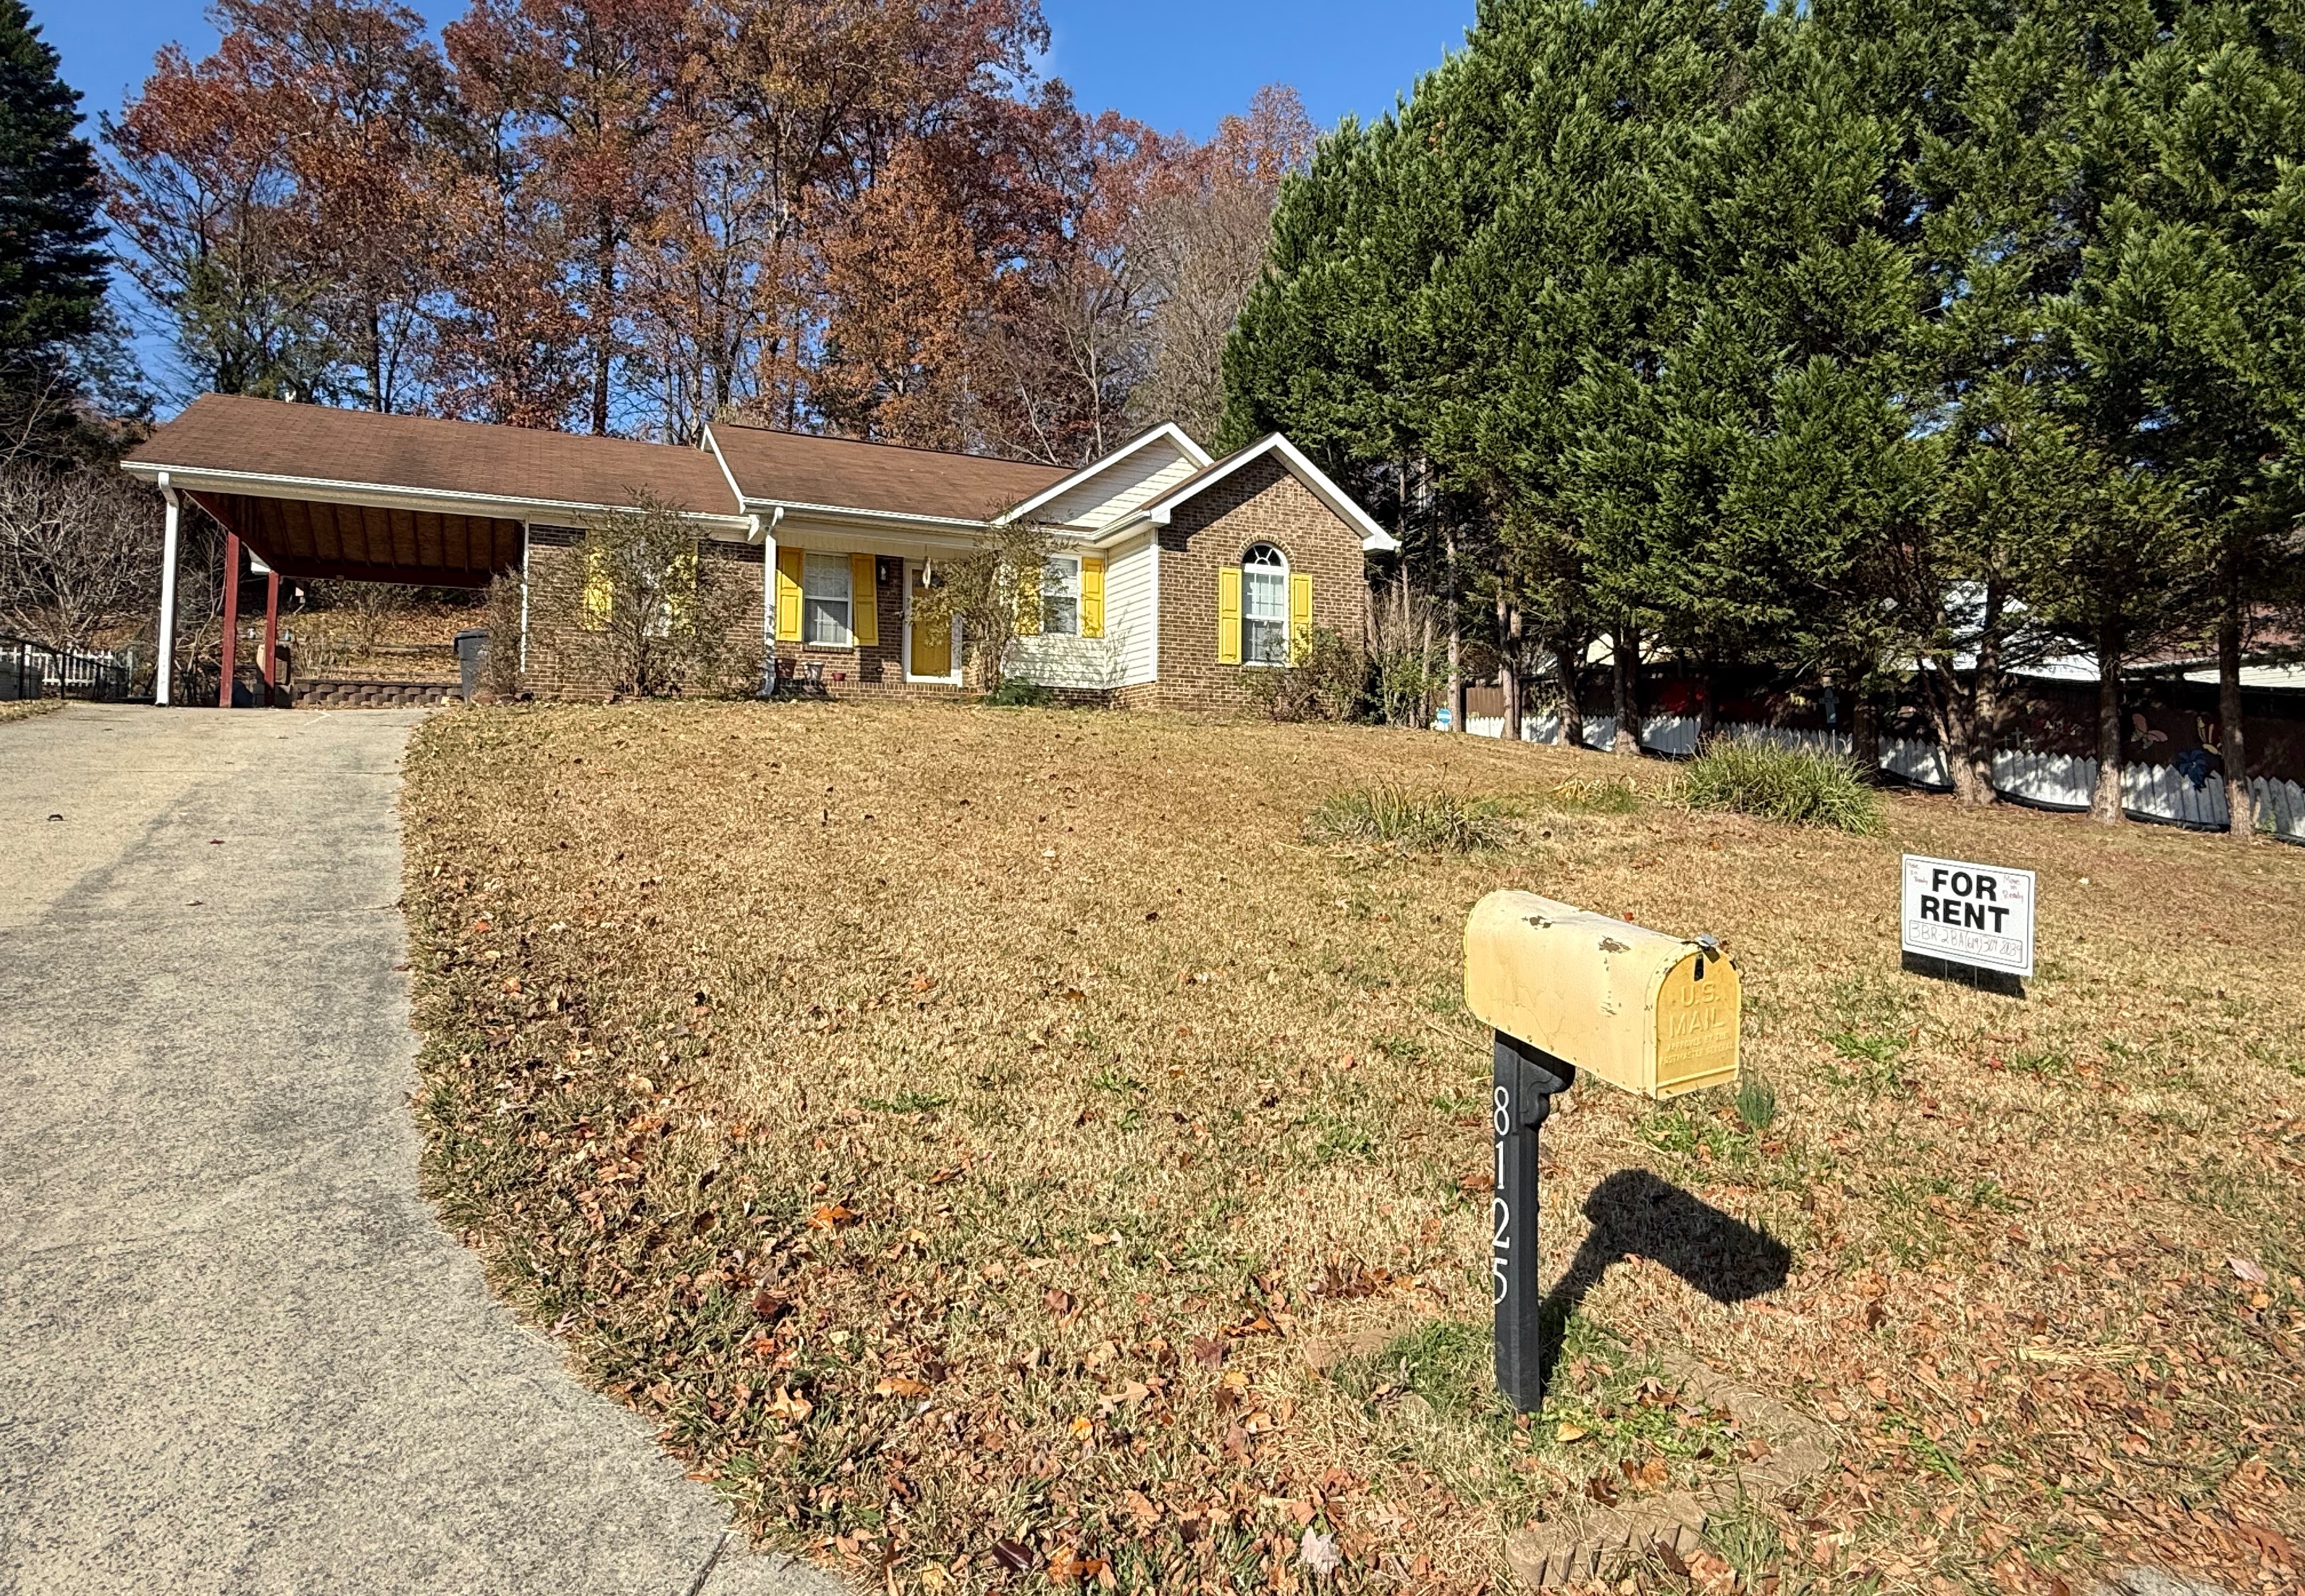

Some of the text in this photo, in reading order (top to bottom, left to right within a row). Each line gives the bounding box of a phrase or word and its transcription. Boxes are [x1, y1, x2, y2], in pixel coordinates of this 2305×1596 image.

[1932, 868, 1997, 902] FOR
[2003, 874, 2021, 885] Move
[2002, 889, 2024, 904] Ready
[1921, 894, 2010, 933] RENT
[1681, 980, 1721, 1008] U.S.
[1669, 1006, 1726, 1038] MAIL
[1704, 1033, 1714, 1044] BY
[1660, 1048, 1704, 1066] POSTMASTER
[1491, 1085, 1511, 1306] 8125
